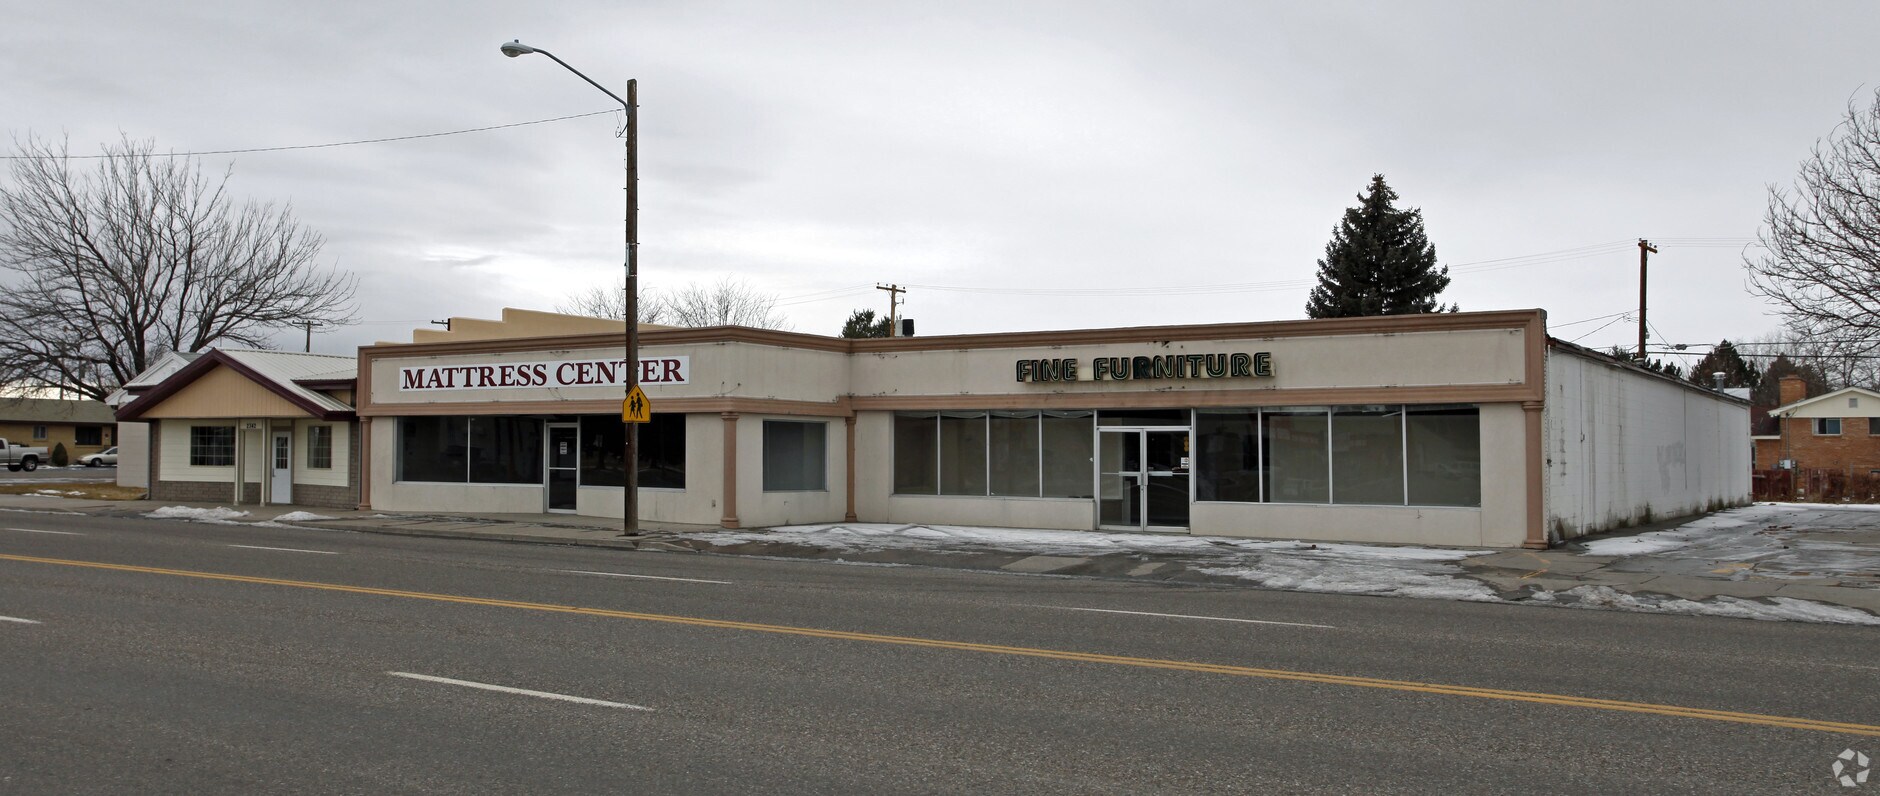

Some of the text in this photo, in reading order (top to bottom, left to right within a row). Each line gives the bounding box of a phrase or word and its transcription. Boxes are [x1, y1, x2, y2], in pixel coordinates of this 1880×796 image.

[403, 364, 547, 389] MATTRESS
[1016, 352, 1271, 382] FINE FURNITURE
